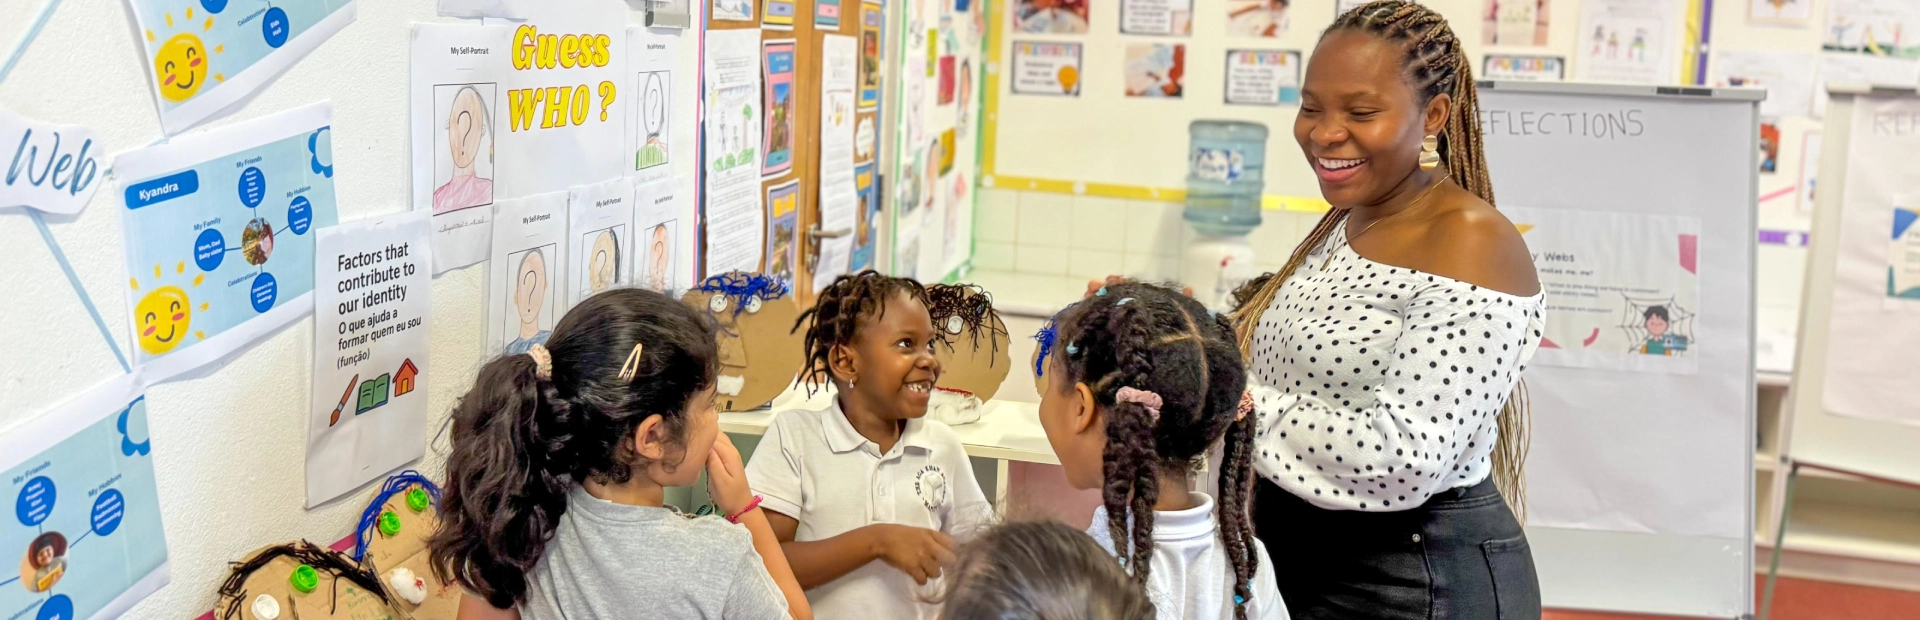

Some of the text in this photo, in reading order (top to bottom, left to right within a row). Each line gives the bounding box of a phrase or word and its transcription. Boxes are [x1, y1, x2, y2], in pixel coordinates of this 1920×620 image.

[451, 47, 459, 56] My
[512, 24, 610, 70] Guess
[508, 80, 616, 132] WHO ?
[1480, 110, 1644, 140] EFLECTIONS
[6, 128, 97, 197] Web
[139, 182, 179, 200] Kyandra
[203, 217, 221, 228] Family
[338, 242, 409, 272] Factors that
[1544, 252, 1574, 262] Webs
[338, 262, 415, 293] contribute to
[338, 284, 407, 315] our identity
[338, 309, 398, 334] O que ajuda a
[338, 316, 422, 351] formar quem eu sou
[337, 348, 370, 370] (função)
